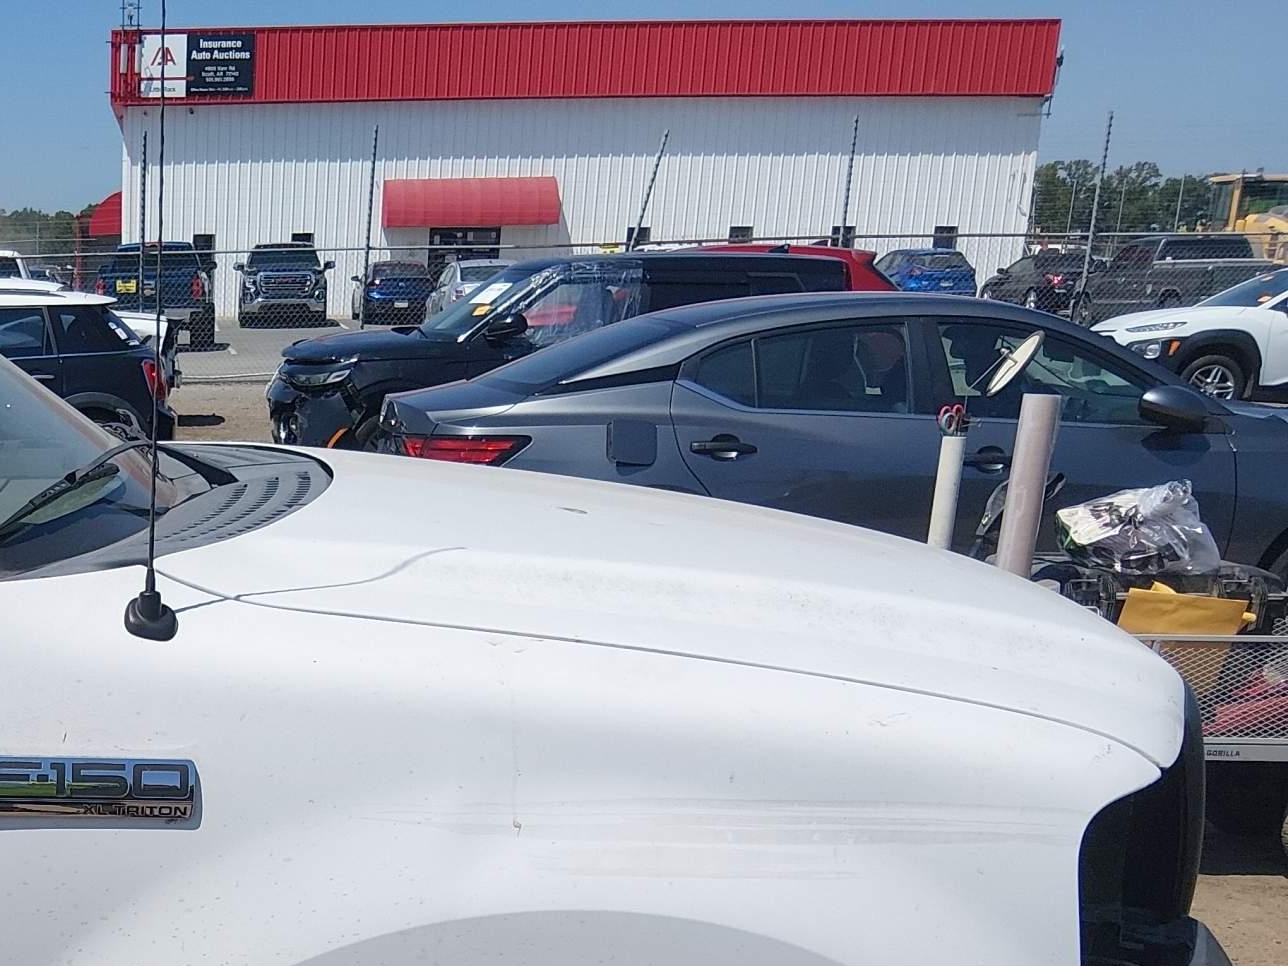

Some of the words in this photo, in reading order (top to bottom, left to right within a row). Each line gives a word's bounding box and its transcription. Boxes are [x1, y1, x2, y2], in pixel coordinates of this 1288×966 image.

[199, 39, 242, 49] Insurance
[191, 50, 211, 60] Auto
[212, 50, 251, 60] Auctions
[1206, 749, 1241, 757] GORILLA
[113, 804, 188, 818] TRITON
